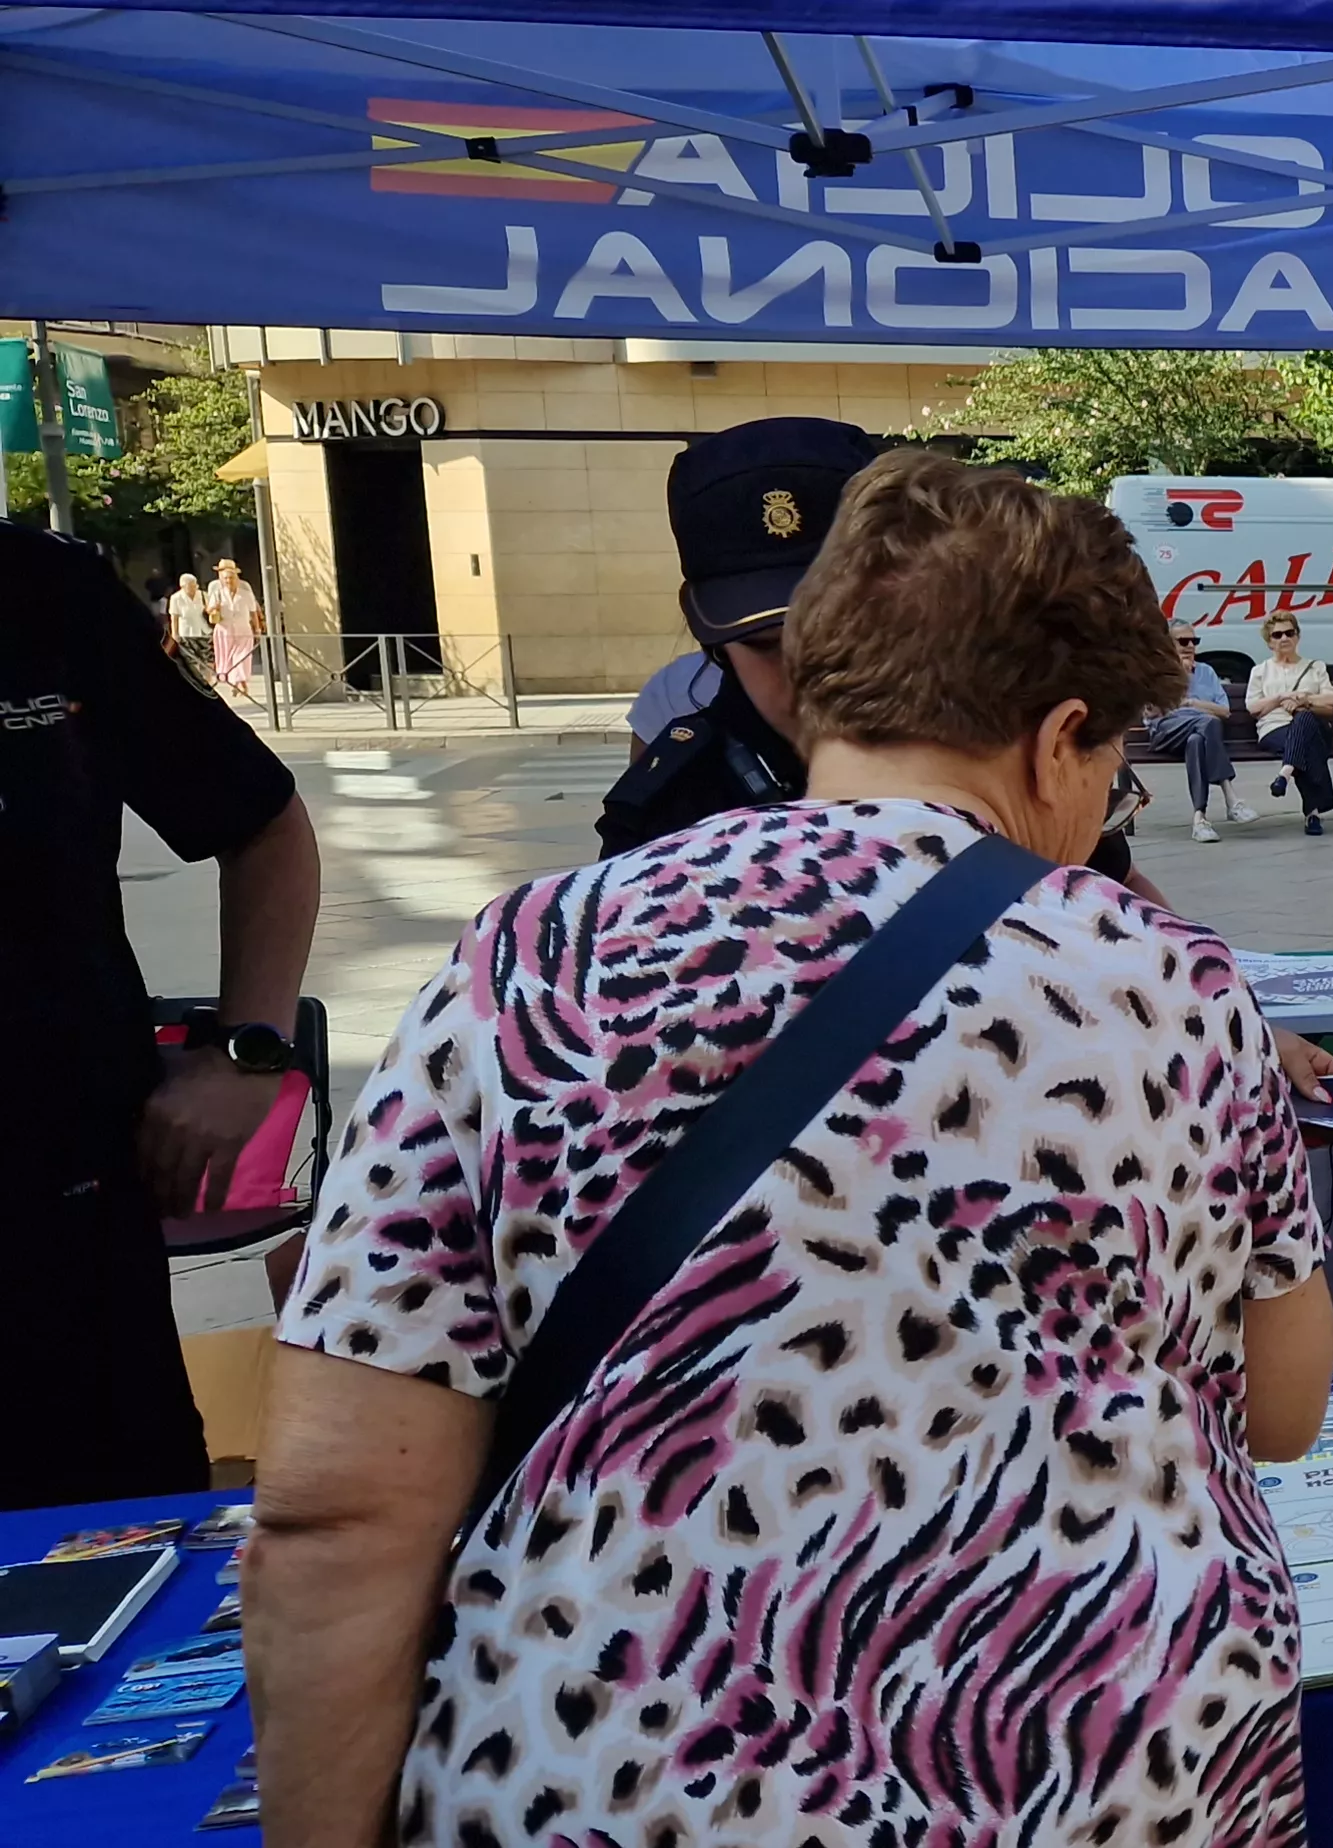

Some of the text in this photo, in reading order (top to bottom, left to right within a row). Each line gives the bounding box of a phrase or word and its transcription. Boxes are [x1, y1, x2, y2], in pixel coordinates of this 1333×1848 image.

[66, 379, 87, 400] San
[69, 398, 110, 422] Lorenzo
[292, 396, 444, 440] MANGO
[4, 711, 66, 729] CNP
